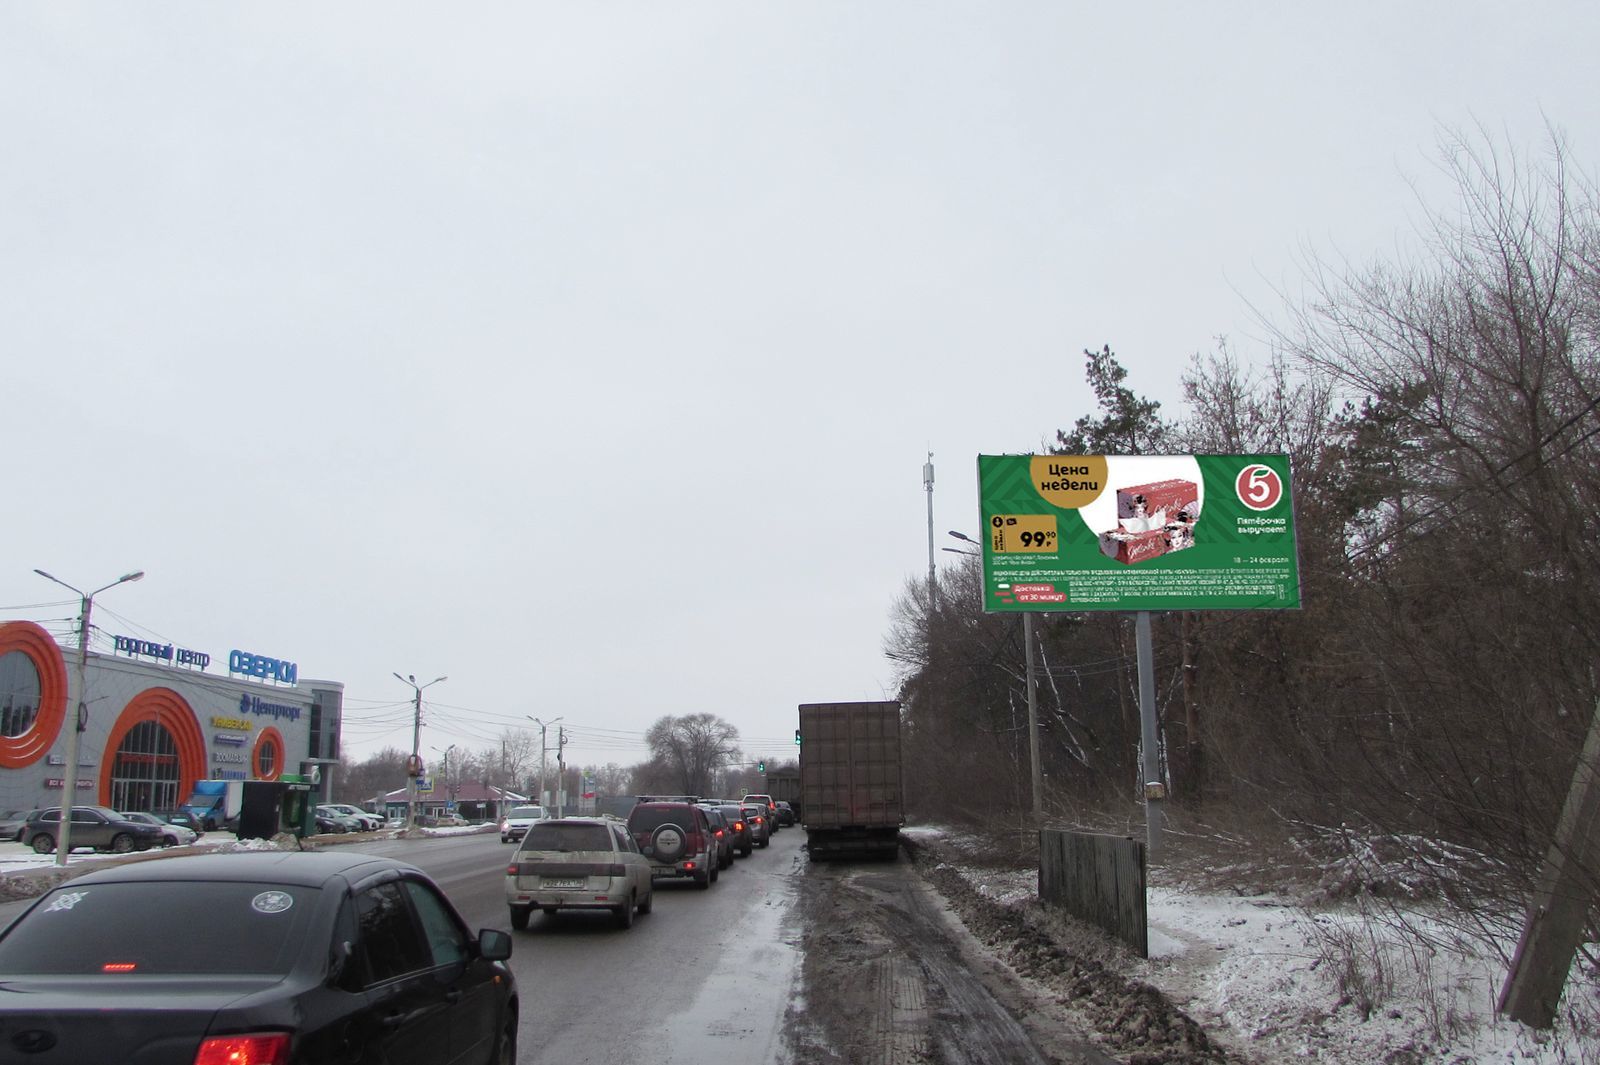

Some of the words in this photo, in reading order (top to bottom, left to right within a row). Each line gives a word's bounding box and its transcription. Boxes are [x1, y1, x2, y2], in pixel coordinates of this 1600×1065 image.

[1048, 464, 1089, 477] Цена
[1041, 478, 1098, 491] недели
[1247, 467, 1271, 503] 5
[1236, 517, 1286, 526] Пятёрочка
[1237, 526, 1287, 535] выручает!
[1020, 531, 1046, 547] 99
[1045, 531, 1056, 539] 90
[1258, 556, 1289, 565] февраля
[1014, 585, 1050, 593] Доставка
[115, 635, 174, 659] торговый
[177, 648, 210, 670] центр
[229, 649, 298, 684] ОЗЕРКИ
[251, 696, 302, 722] Центрторг
